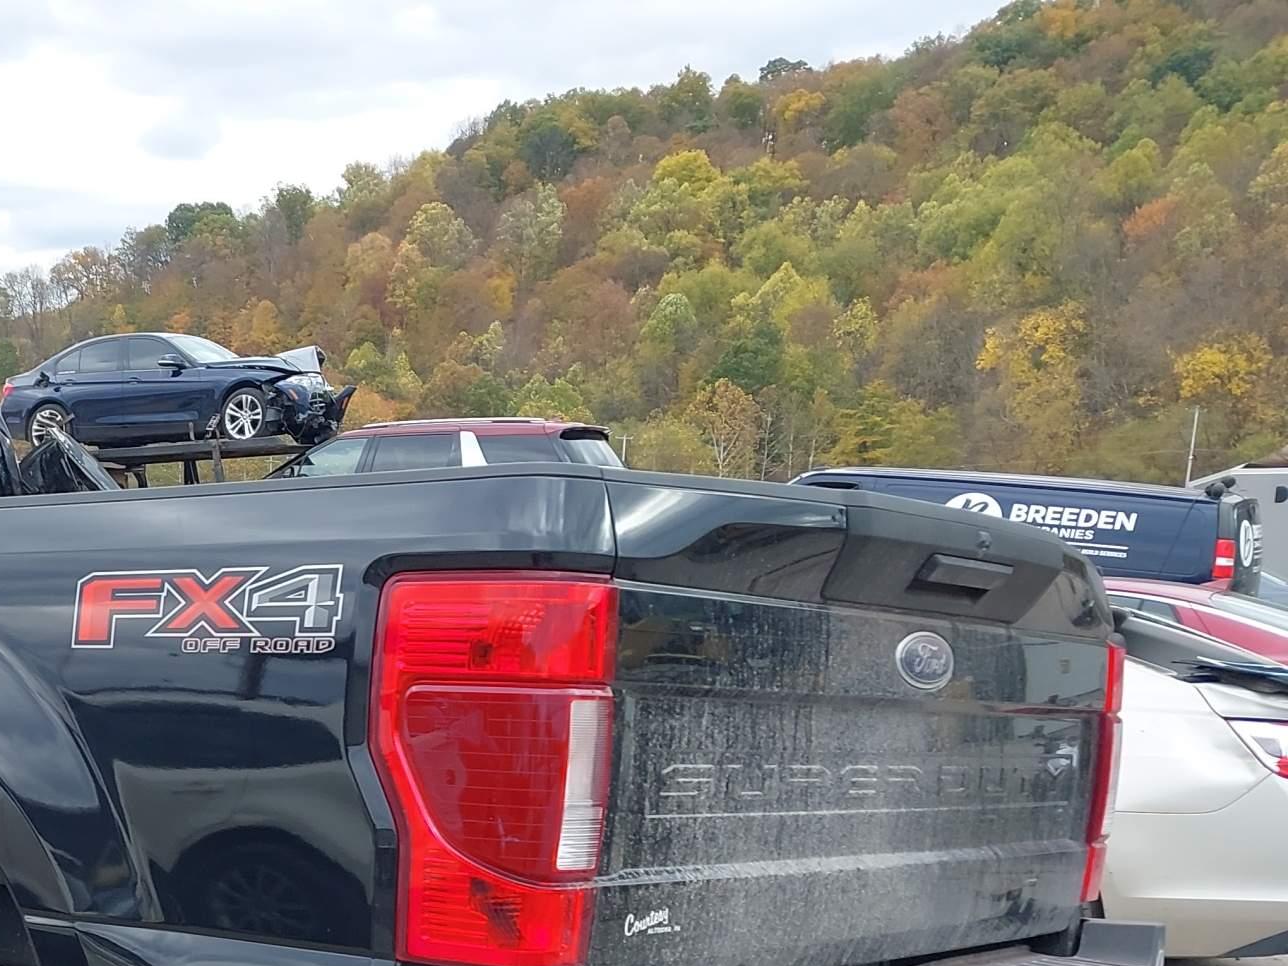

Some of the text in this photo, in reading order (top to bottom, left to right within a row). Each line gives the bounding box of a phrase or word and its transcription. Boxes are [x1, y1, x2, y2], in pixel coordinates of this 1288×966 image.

[1009, 503, 1138, 532] BREEDEN
[72, 565, 343, 648] FX4
[181, 636, 335, 654] OFF ROAD
[624, 906, 669, 936] Courtesy
